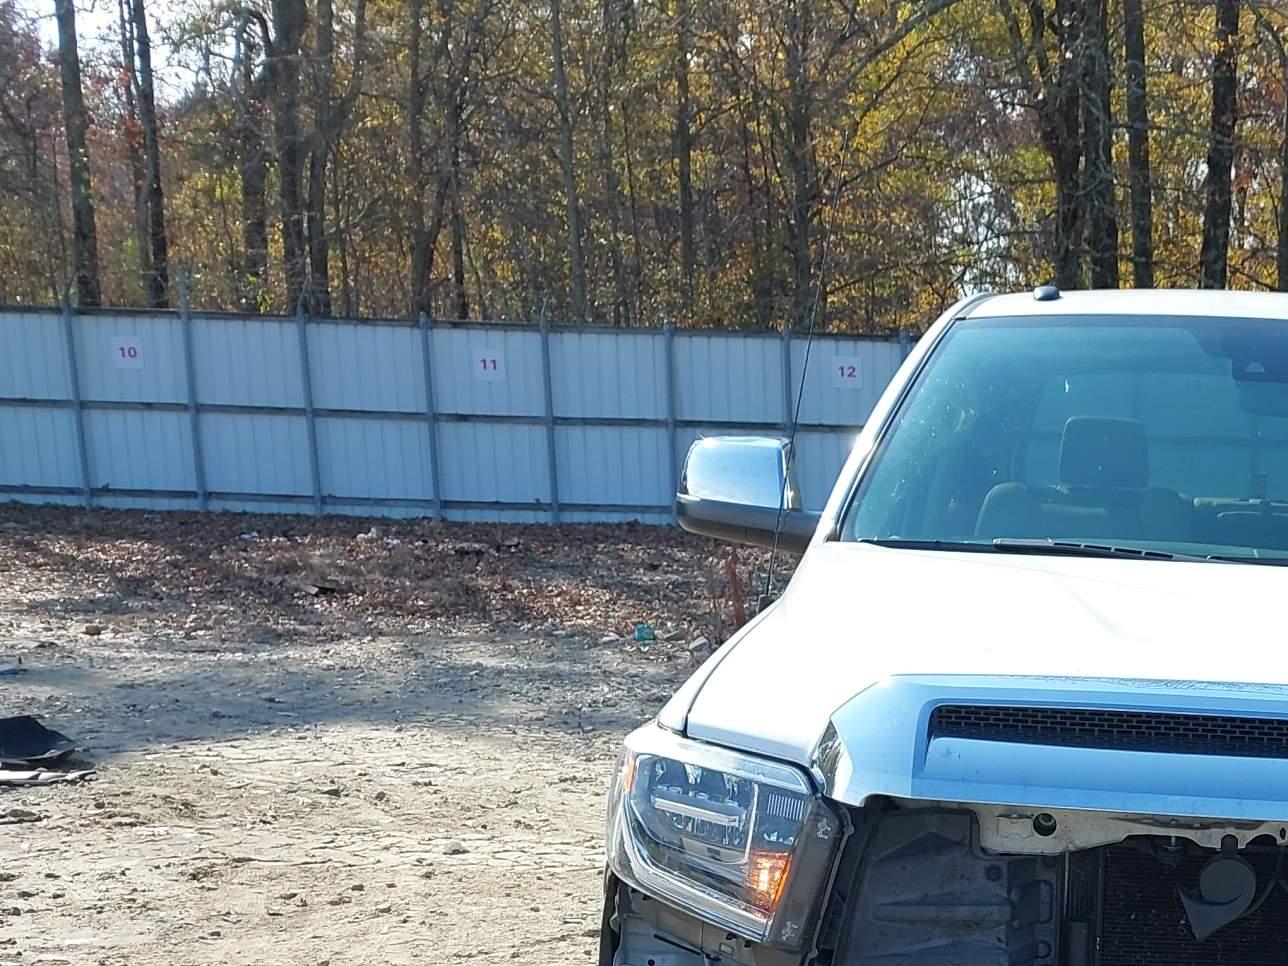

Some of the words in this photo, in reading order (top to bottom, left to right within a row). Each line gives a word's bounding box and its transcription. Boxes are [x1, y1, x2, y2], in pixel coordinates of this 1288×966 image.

[118, 346, 137, 358] 10
[480, 358, 498, 371] 11
[838, 366, 857, 378] 12
